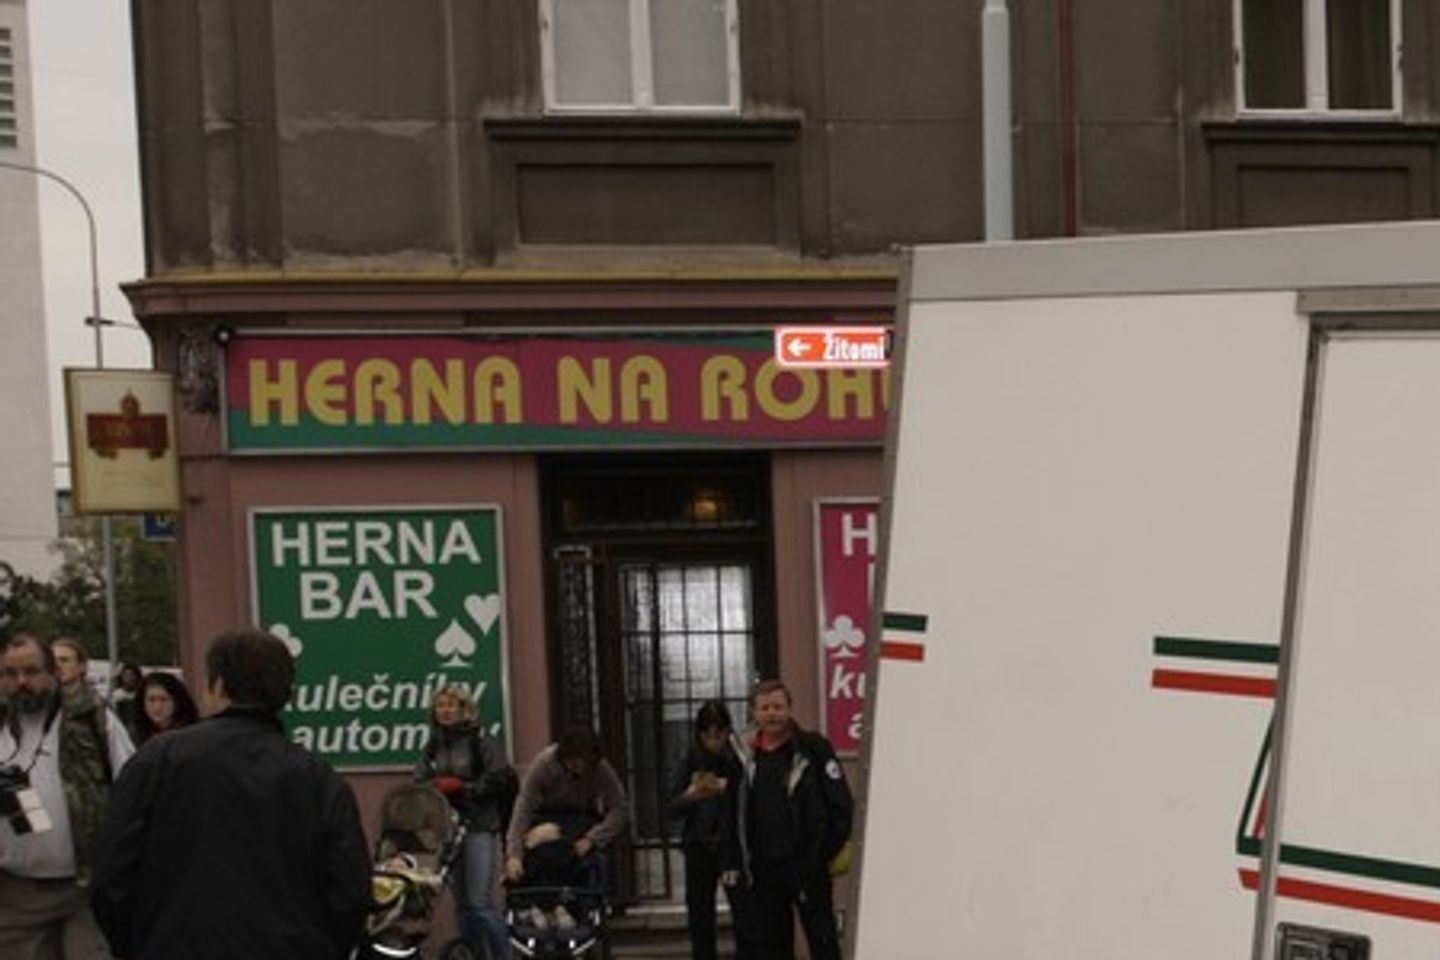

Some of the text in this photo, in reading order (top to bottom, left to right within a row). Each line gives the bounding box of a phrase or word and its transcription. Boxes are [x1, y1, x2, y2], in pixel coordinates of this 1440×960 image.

[249, 354, 892, 427] HERNA NA ROH
[271, 519, 483, 567] HERNA
[301, 569, 439, 620] BAR
